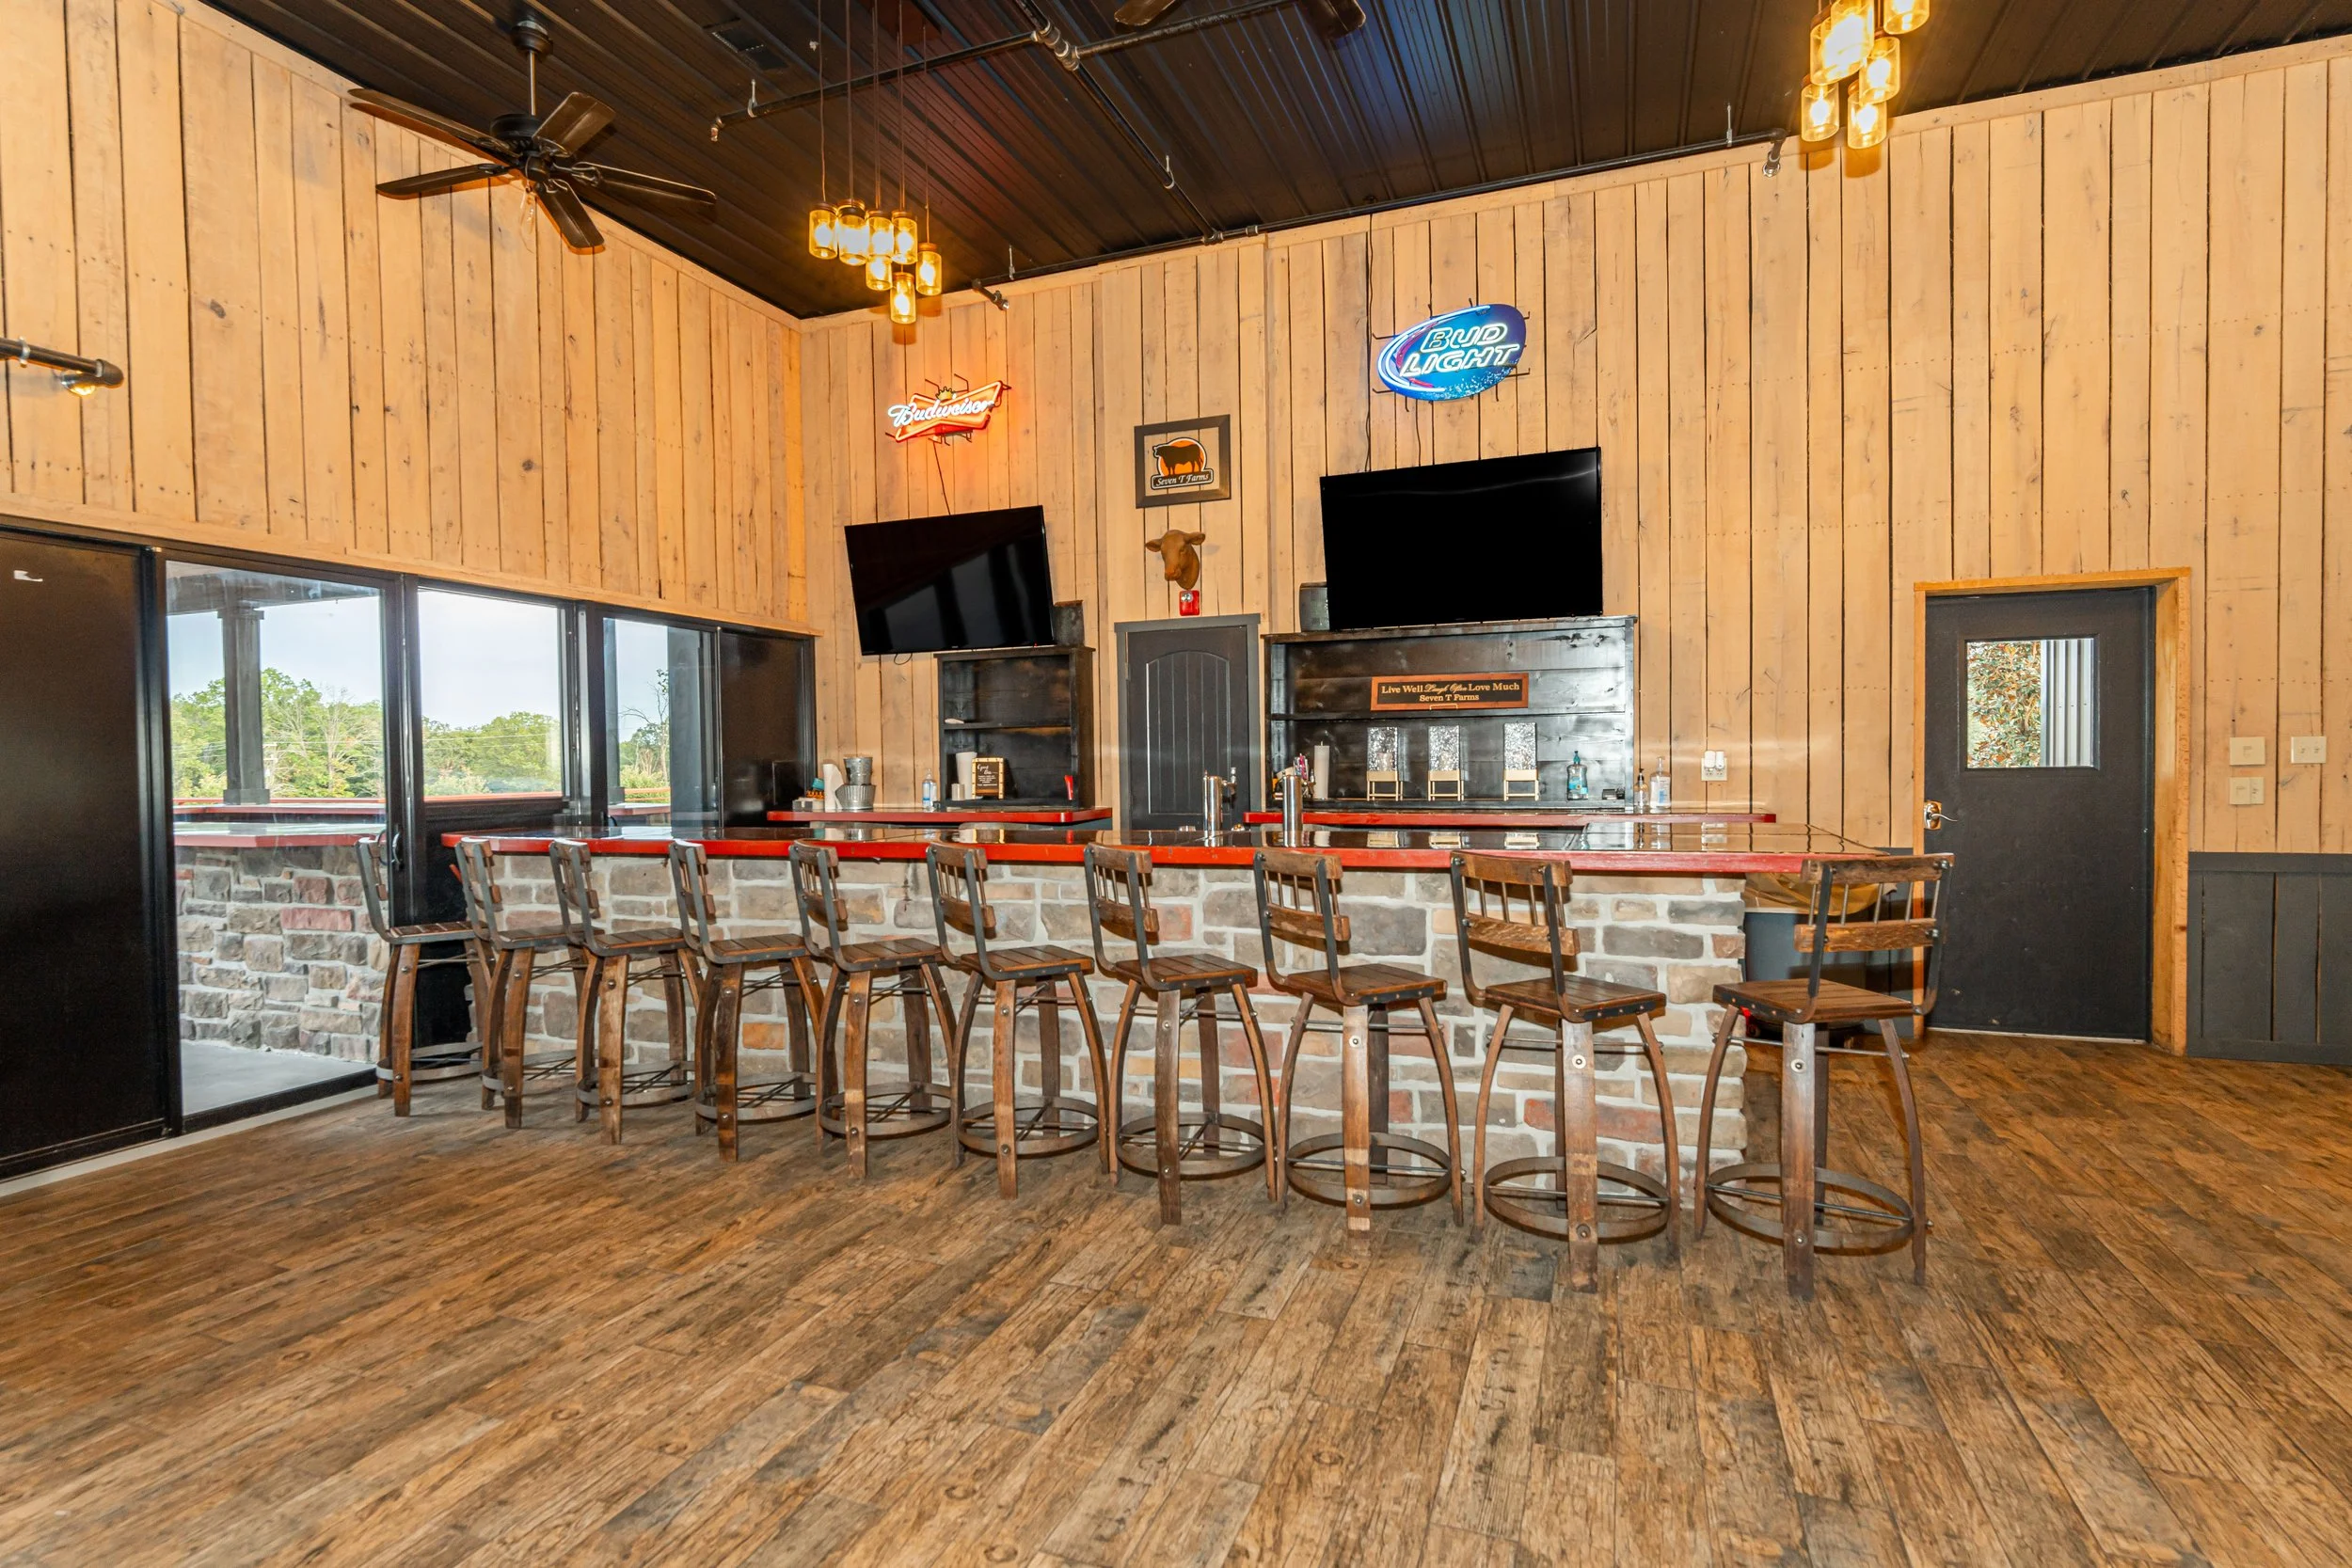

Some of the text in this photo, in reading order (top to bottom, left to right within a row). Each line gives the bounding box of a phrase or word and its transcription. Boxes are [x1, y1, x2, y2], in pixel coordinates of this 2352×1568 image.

[1421, 323, 1508, 353] BUD
[1400, 344, 1520, 377] LIGHT
[887, 397, 995, 427] Budweiser
[1156, 473, 1210, 486] Seven T Farms
[1381, 686, 1401, 694] Live
[1402, 685, 1422, 693] Well
[1468, 683, 1490, 691] Love
[1492, 682, 1520, 690] Much
